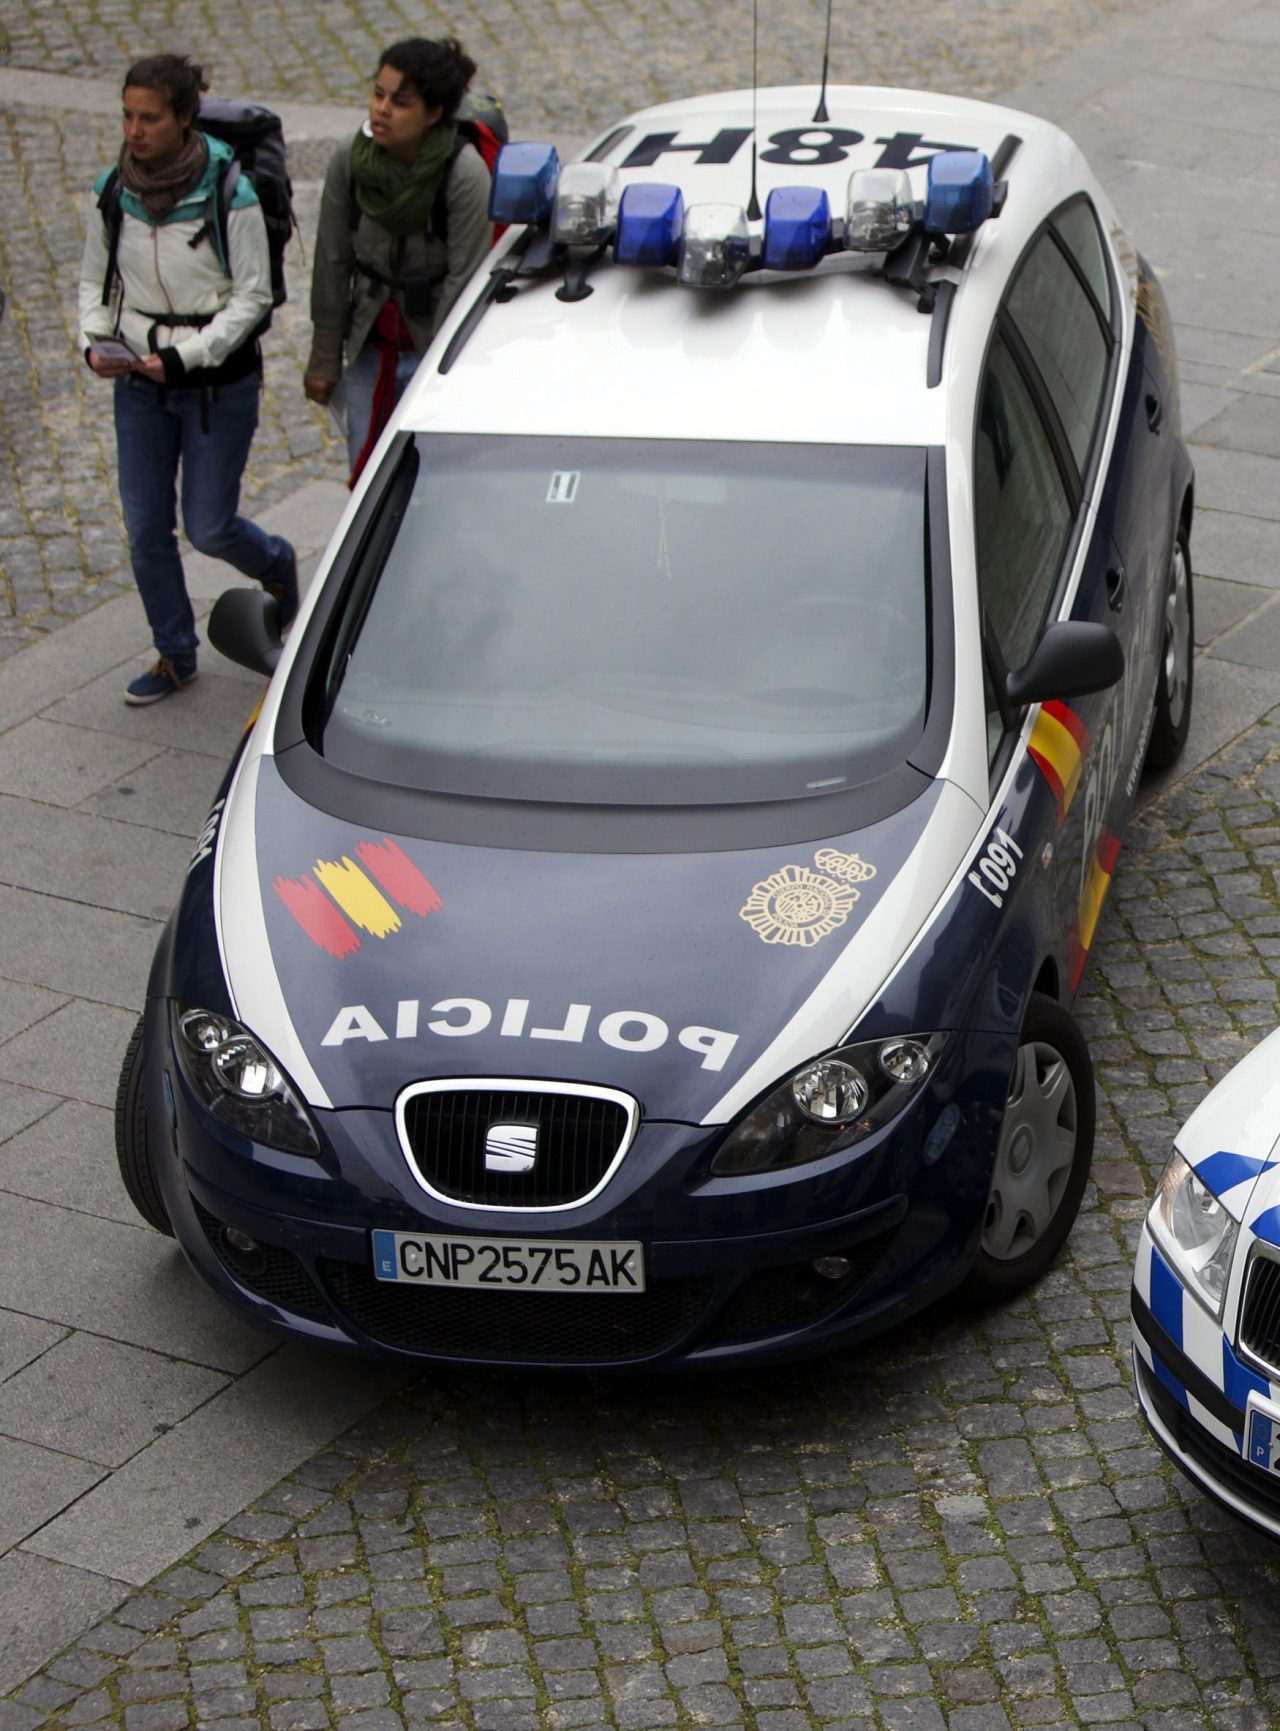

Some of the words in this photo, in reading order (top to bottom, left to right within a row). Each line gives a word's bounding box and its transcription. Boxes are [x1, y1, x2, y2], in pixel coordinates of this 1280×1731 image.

[381, 1260, 392, 1273] E
[399, 1239, 638, 1287] CNP2575AK
[1256, 1445, 1265, 1457] P
